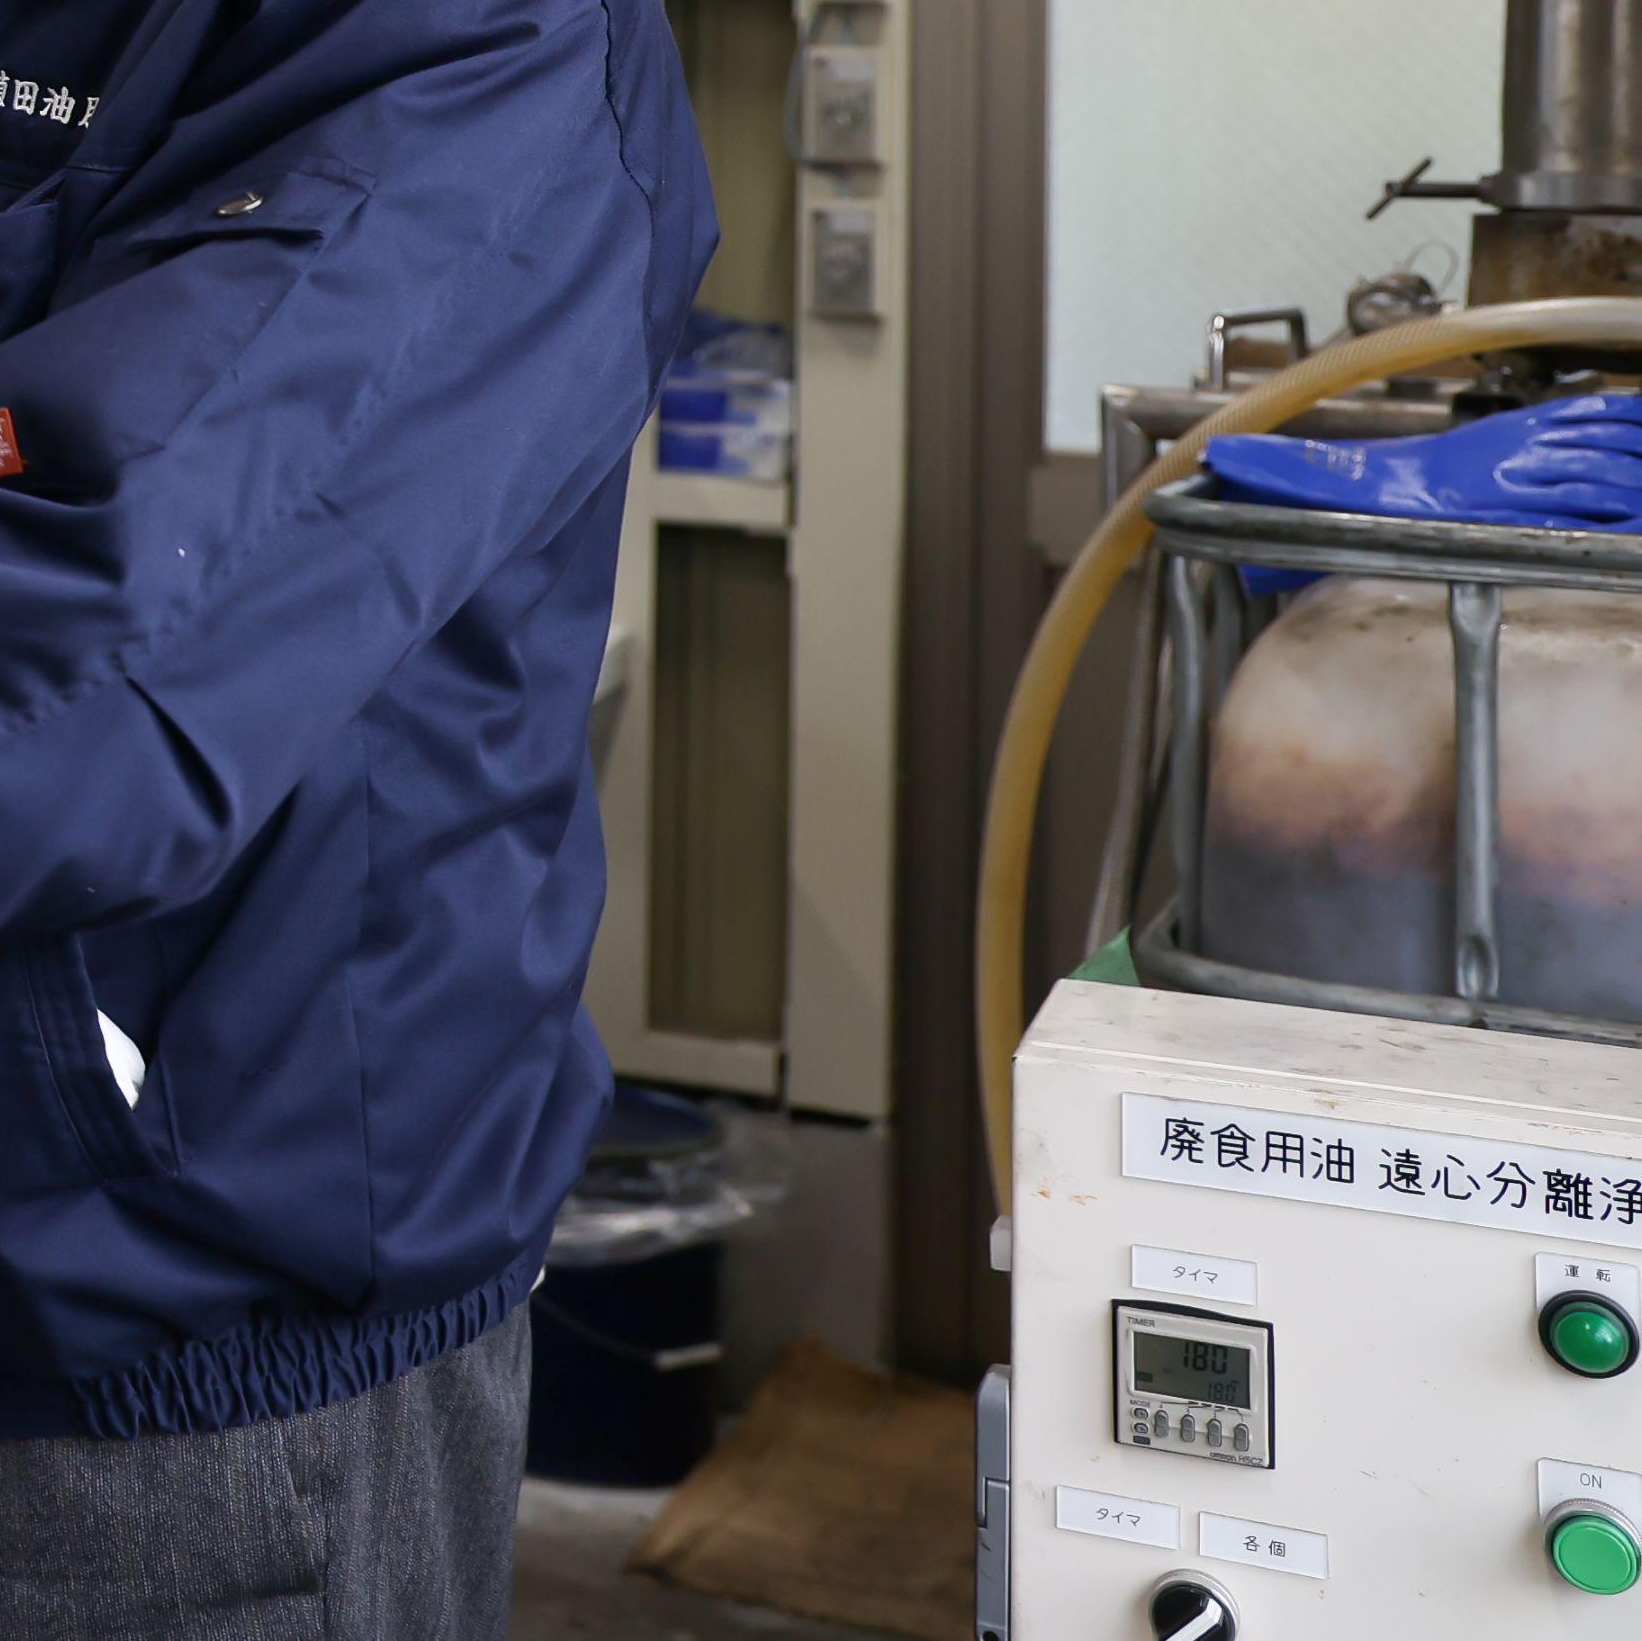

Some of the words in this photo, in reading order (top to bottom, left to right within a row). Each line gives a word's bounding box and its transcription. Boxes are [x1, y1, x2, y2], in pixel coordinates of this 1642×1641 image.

[1159, 1116, 1356, 1184] 廃食用油
[1377, 1147, 1642, 1225] 遠心分離浄
[1172, 1265, 1219, 1284] タイマ
[1126, 1316, 1156, 1328] TIMER
[1579, 1472, 1603, 1489] ON
[1095, 1508, 1141, 1527] タイマ
